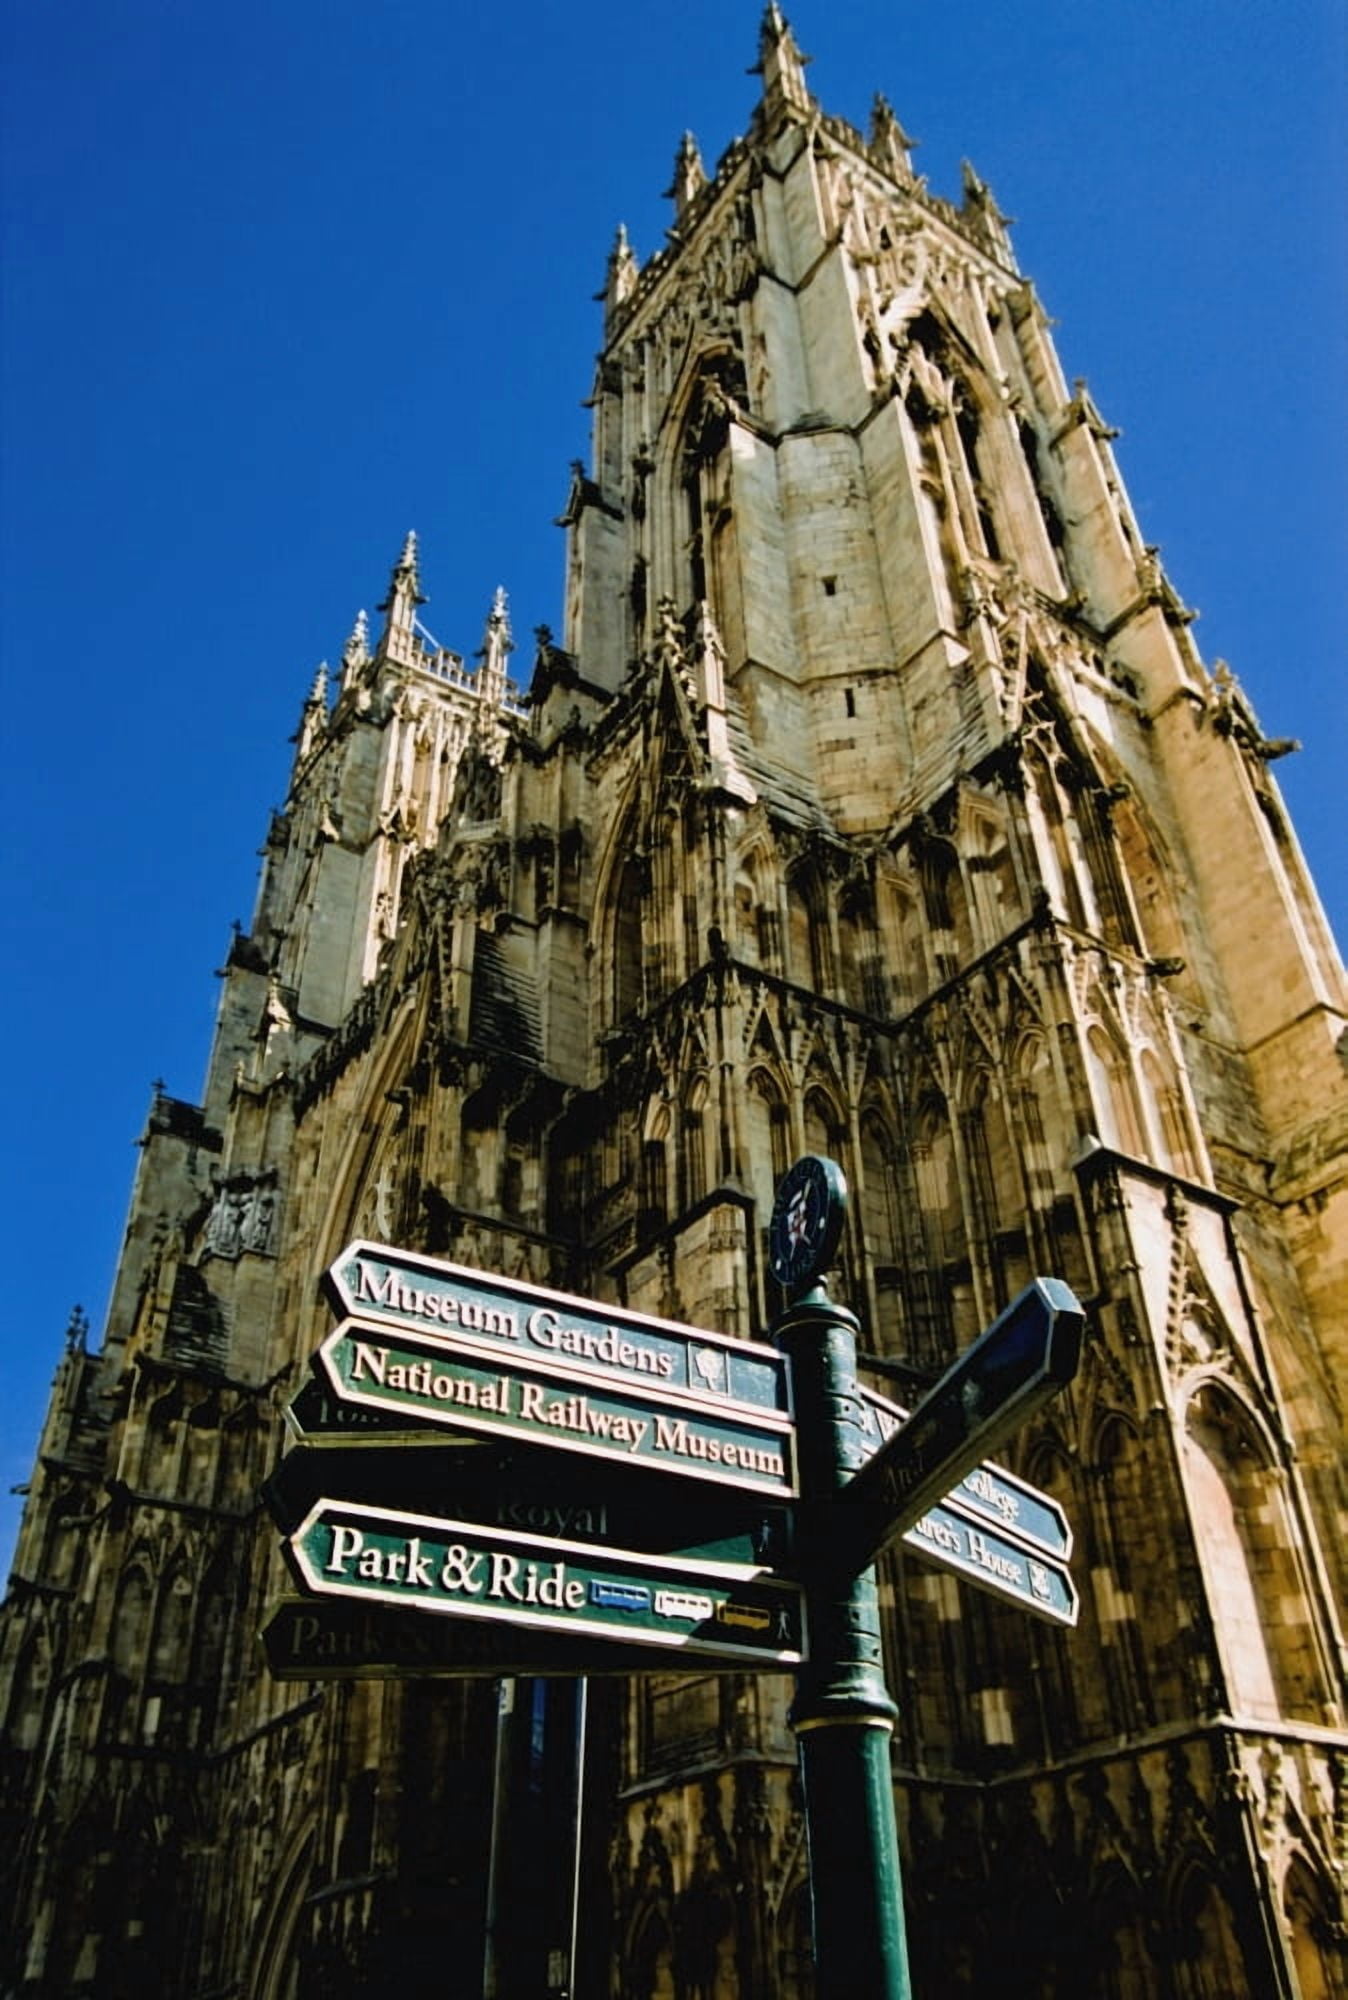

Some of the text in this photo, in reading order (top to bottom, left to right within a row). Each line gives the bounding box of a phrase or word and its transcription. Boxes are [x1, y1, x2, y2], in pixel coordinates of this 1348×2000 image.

[356, 1262, 674, 1376] Museum Gardens
[351, 1343, 510, 1415] National
[519, 1385, 648, 1452] Railway
[654, 1418, 785, 1477] Museum
[325, 1524, 587, 1610] Park & Ride
[965, 1528, 1023, 1585] House
